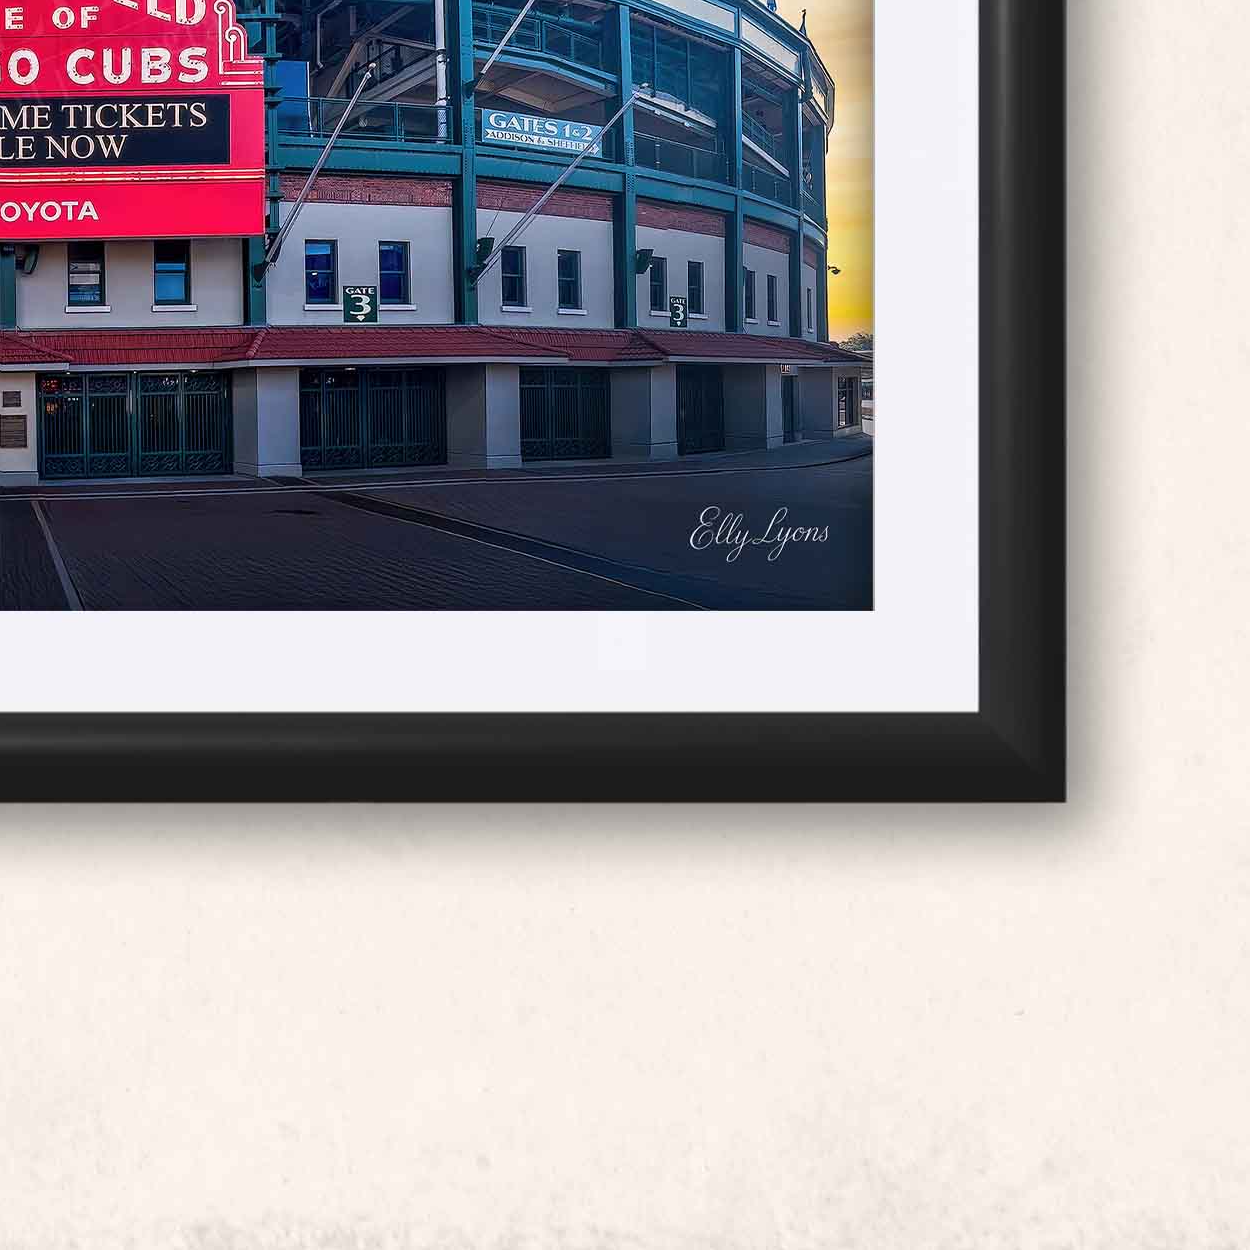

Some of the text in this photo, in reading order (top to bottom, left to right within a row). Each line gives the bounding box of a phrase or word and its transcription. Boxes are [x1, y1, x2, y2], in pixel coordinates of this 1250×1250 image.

[52, 6, 100, 30] OF
[66, 46, 209, 85] CUBS
[61, 102, 207, 129] TICKETS
[489, 112, 593, 141] GATES 1&2
[45, 133, 128, 160] NOW
[489, 131, 534, 143] ADDISON
[345, 287, 375, 295] GATE
[350, 294, 372, 315] 3
[673, 303, 685, 321] 3
